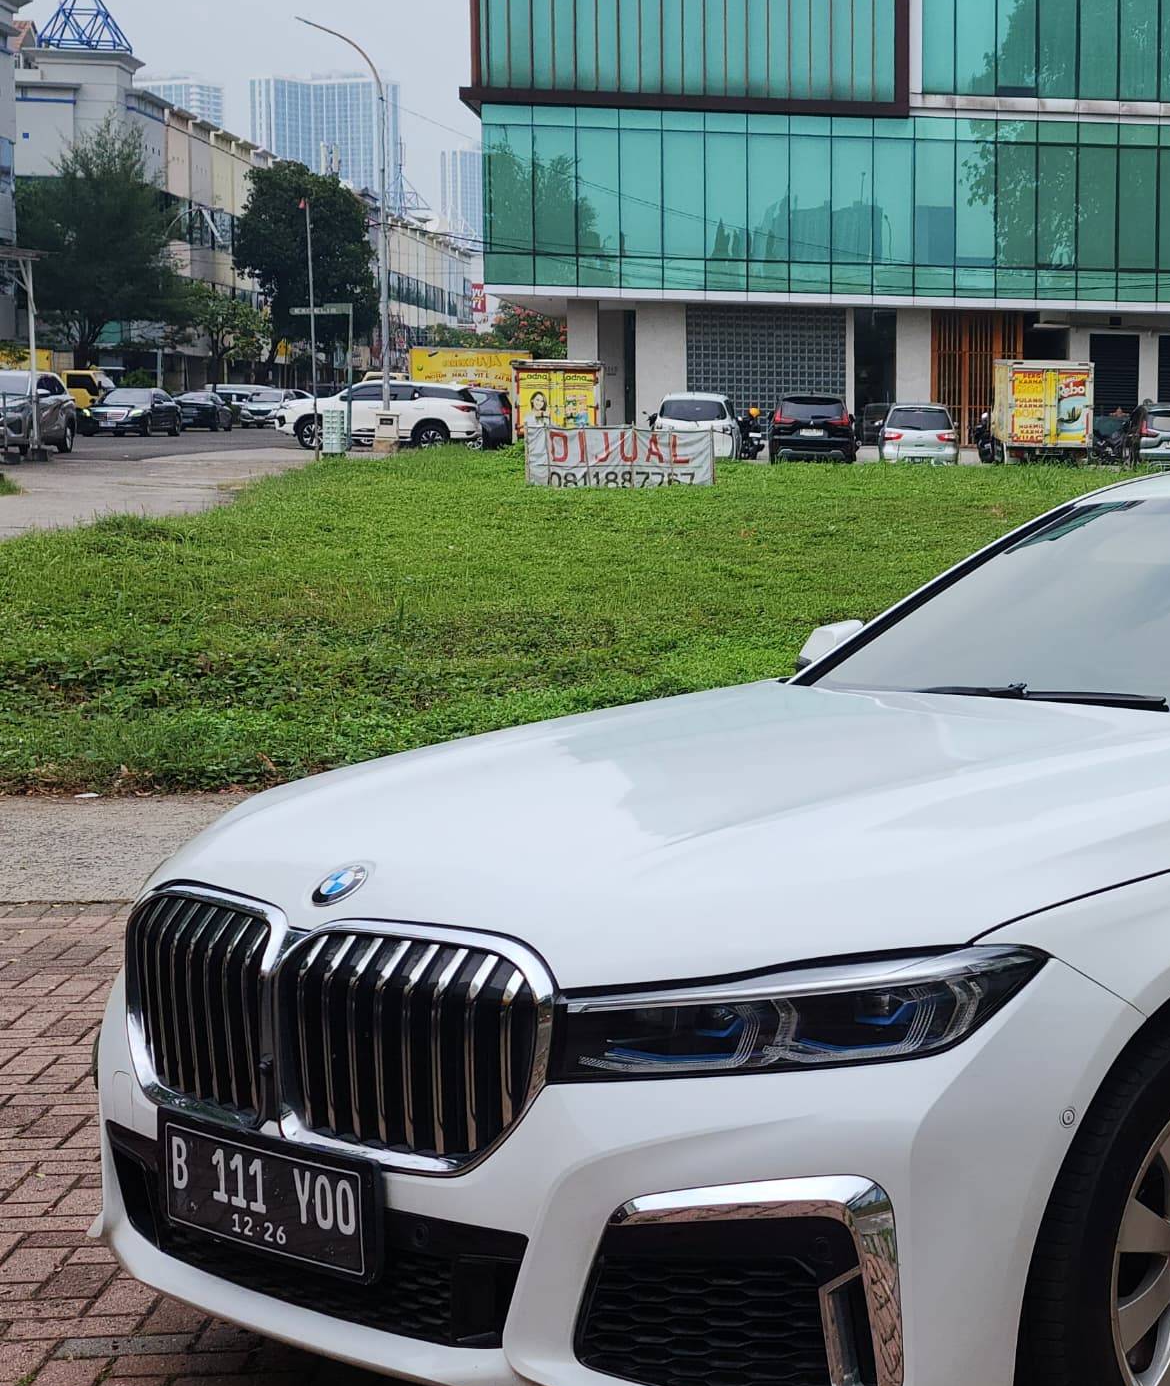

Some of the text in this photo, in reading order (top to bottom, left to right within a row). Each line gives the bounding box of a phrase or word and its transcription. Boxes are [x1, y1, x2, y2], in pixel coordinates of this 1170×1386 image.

[1059, 382, 1085, 397] Rebo
[550, 430, 690, 464] DIJUAL
[171, 1135, 189, 1190] B
[211, 1148, 267, 1214] 111
